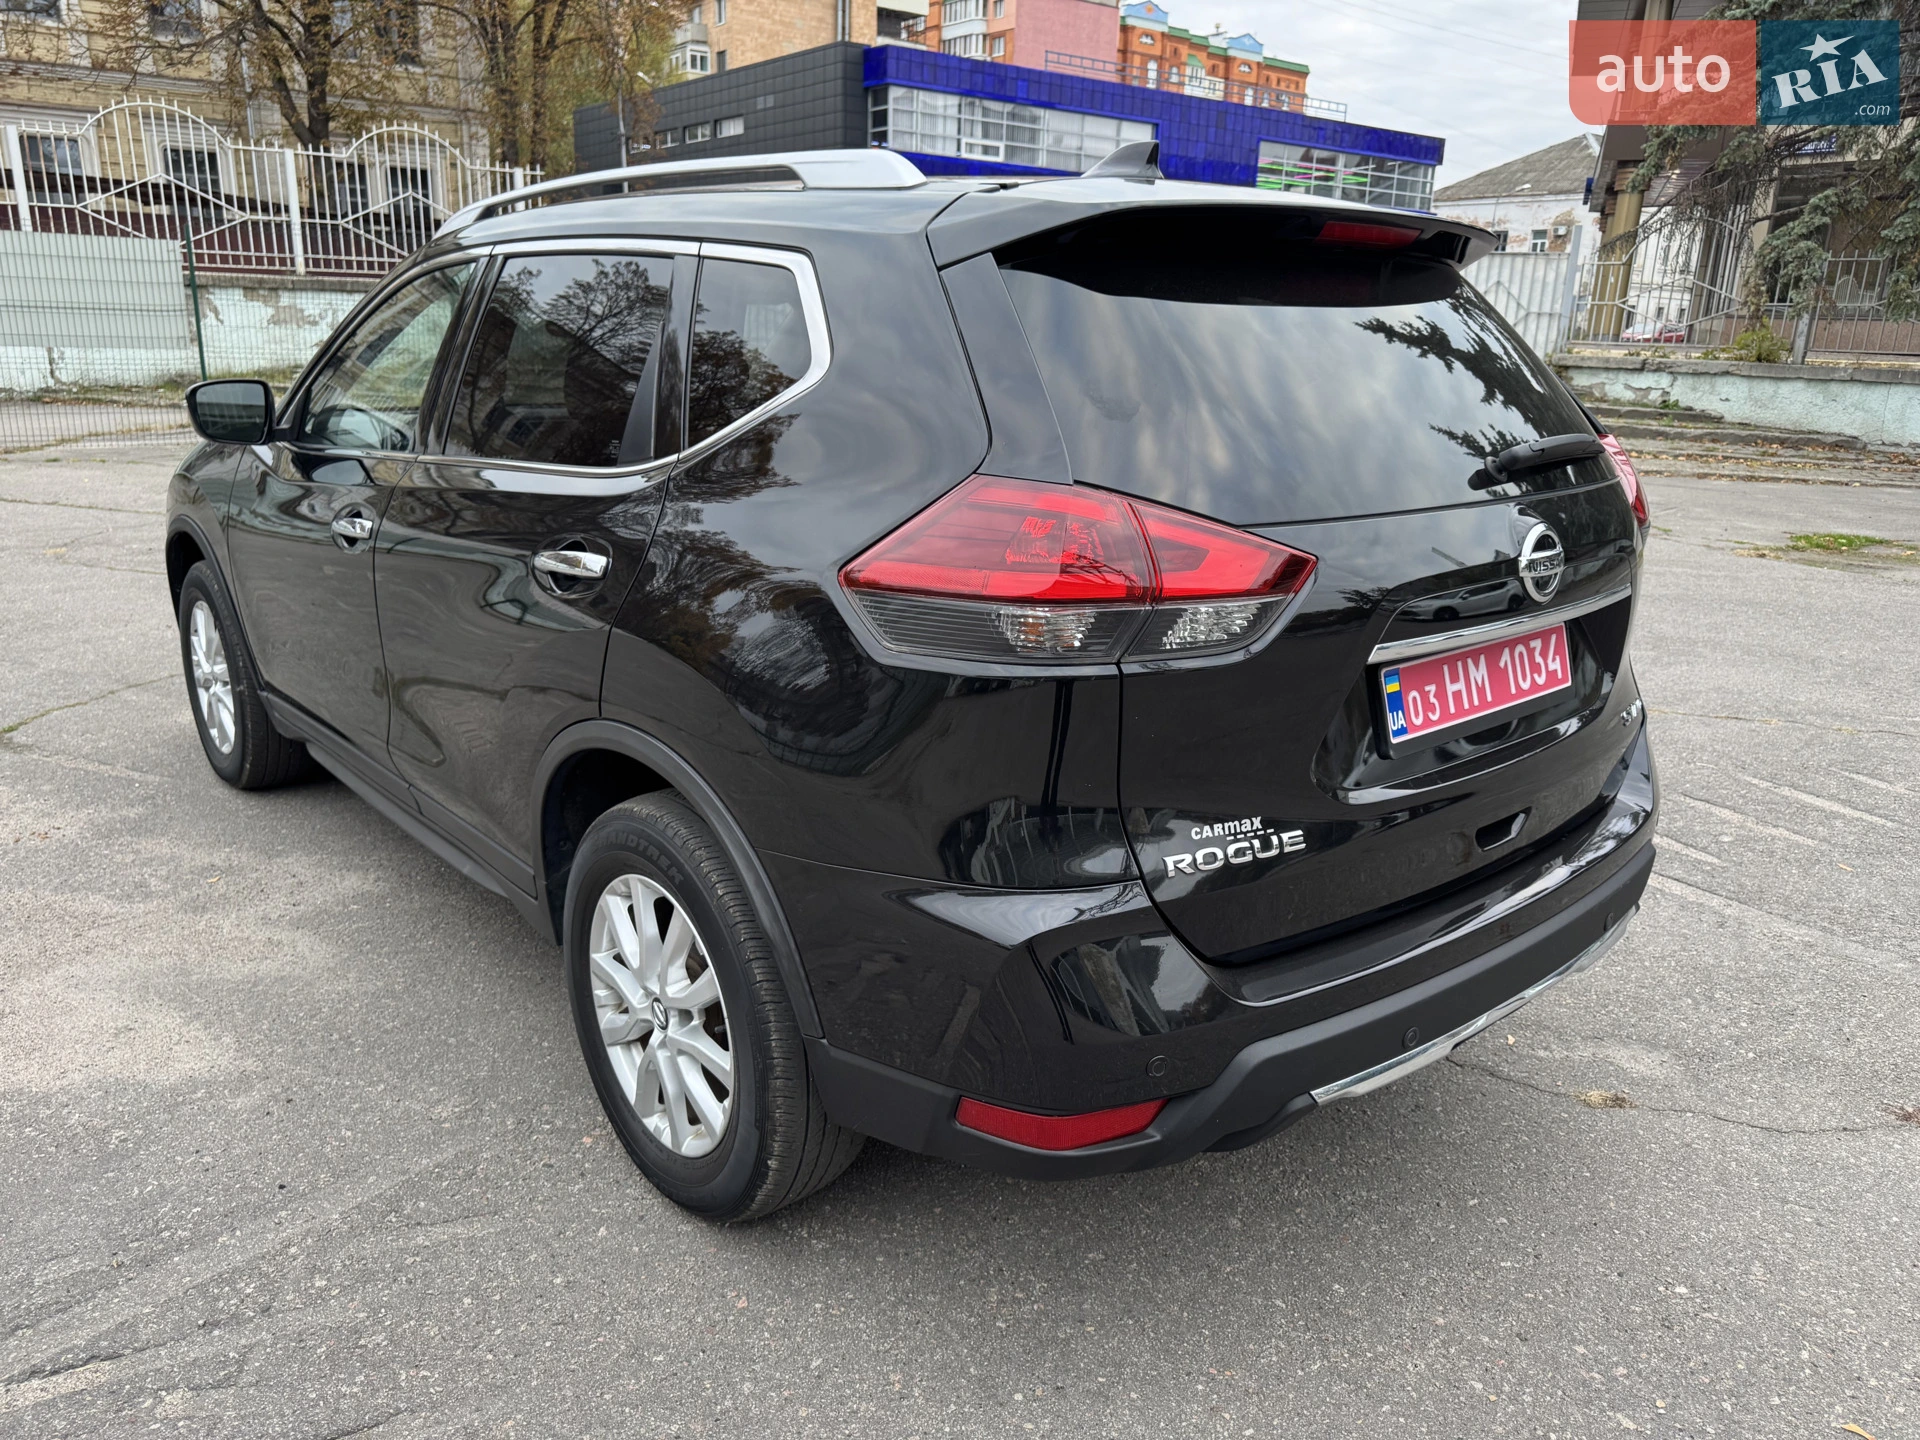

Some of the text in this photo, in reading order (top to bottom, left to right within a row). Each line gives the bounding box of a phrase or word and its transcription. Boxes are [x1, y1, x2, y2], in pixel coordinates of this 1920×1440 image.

[1408, 684, 1441, 727] 03
[1498, 633, 1563, 696] 1034
[1390, 709, 1407, 732] UA
[1162, 829, 1307, 878] ROGUE
